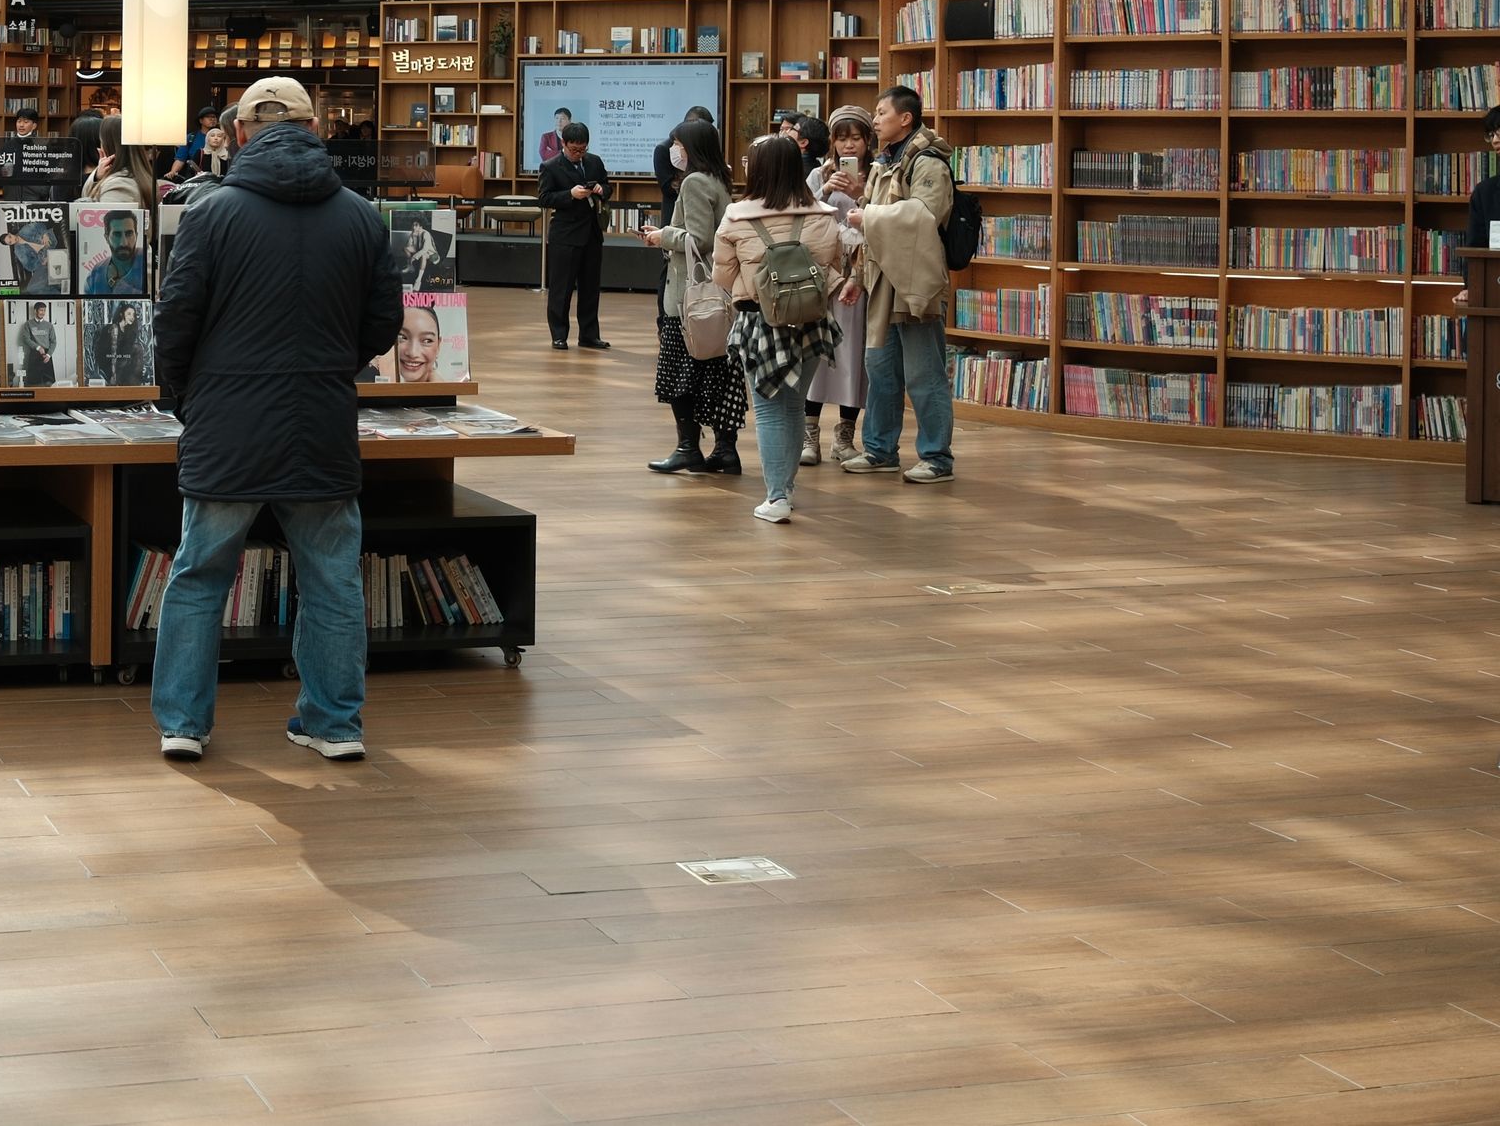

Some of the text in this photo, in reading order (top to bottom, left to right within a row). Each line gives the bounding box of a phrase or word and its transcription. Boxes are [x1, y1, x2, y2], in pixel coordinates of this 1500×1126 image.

[8, 19, 27, 31] 소설
[599, 100, 645, 111] 곽효환 시인
[4, 206, 64, 223] allure
[403, 293, 467, 308] OSMOPOLITAN
